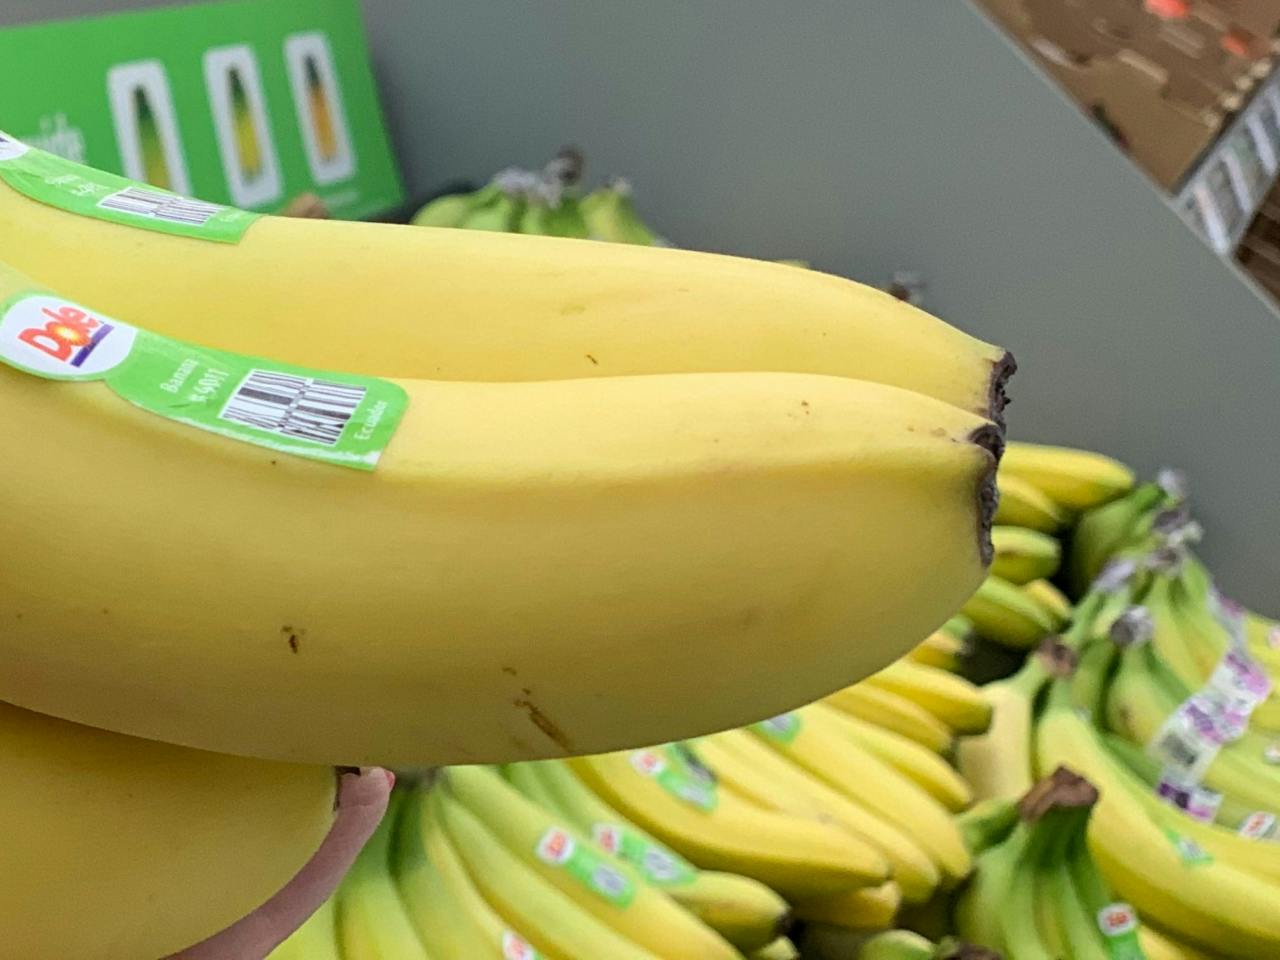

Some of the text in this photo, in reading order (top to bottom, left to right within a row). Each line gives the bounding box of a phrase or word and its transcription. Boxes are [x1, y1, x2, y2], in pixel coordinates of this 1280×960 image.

[17, 305, 100, 363] Dole
[159, 357, 200, 394] Banana
[353, 398, 389, 440] Ecuador
